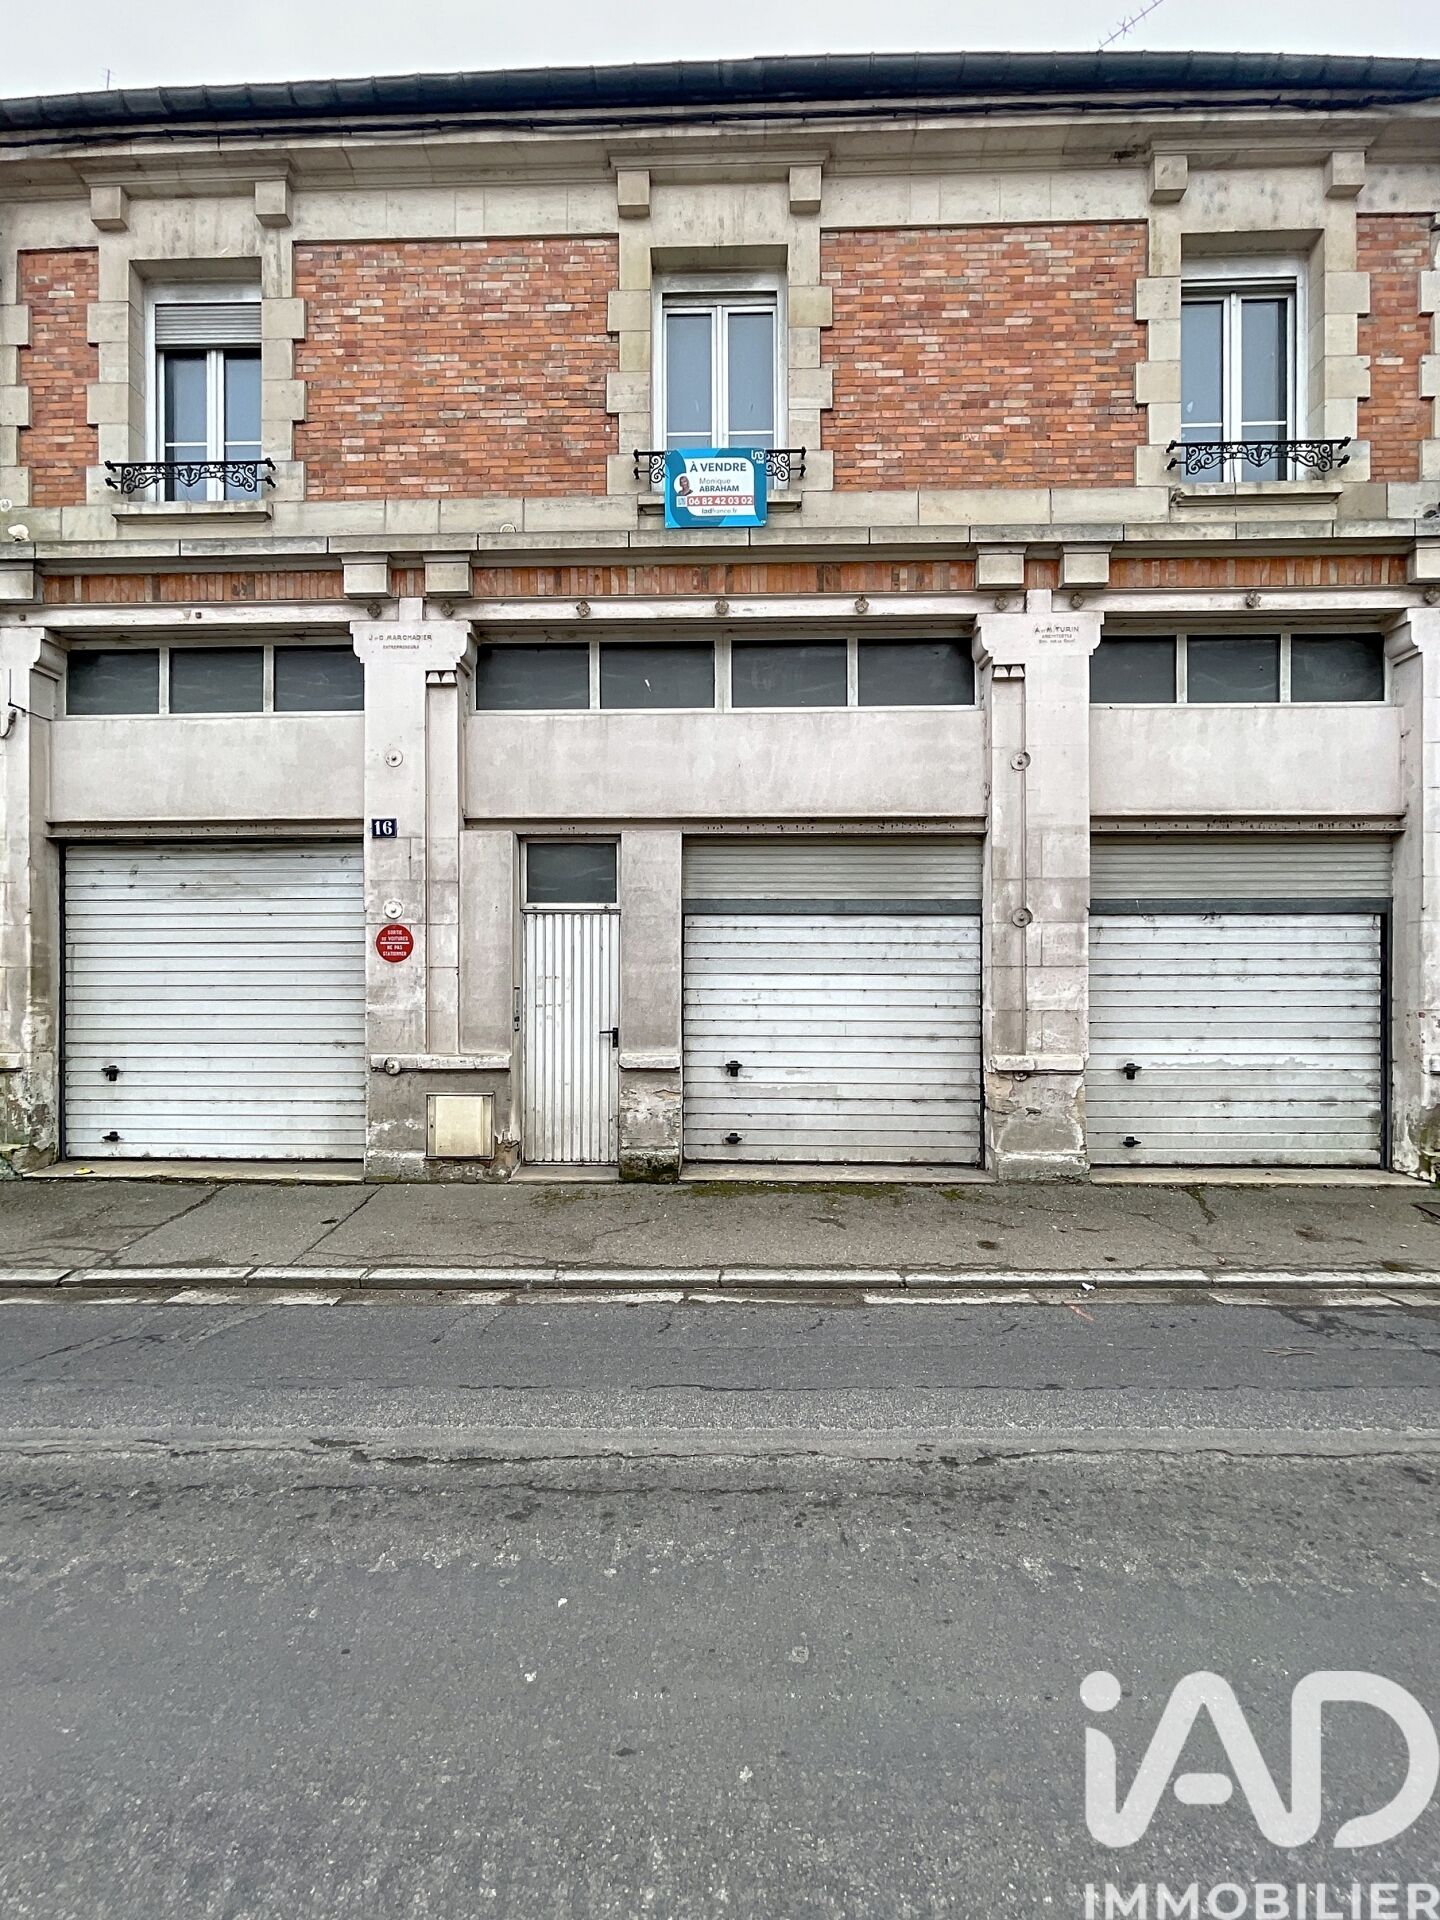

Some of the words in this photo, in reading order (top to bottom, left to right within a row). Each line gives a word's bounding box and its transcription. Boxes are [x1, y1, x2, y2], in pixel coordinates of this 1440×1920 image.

[689, 460, 698, 473] À
[700, 462, 747, 472] VENDRE
[699, 477, 731, 486] Monique
[688, 497, 700, 505] 06
[701, 497, 713, 505] 82
[714, 497, 726, 505] 42
[727, 496, 740, 505] 03
[741, 496, 753, 505] 02
[374, 820, 393, 836] 16
